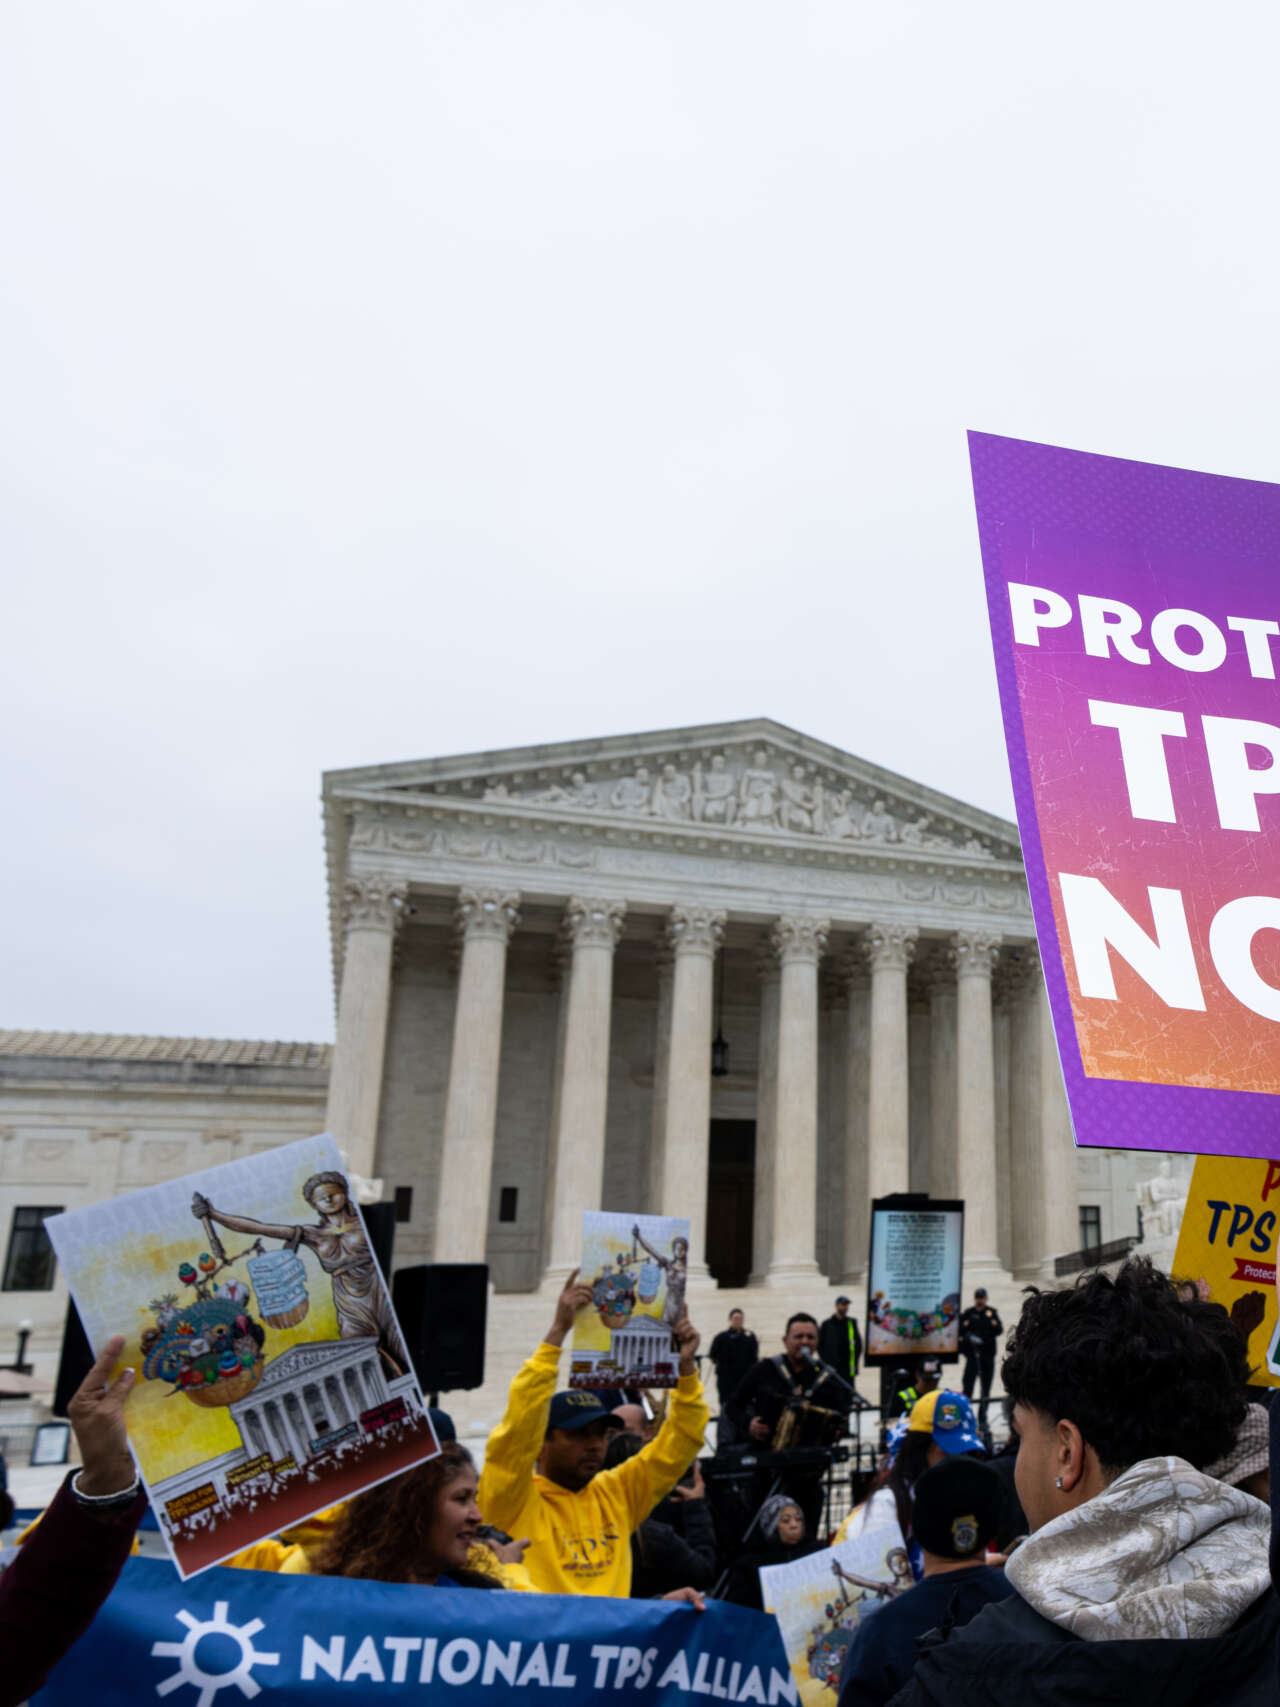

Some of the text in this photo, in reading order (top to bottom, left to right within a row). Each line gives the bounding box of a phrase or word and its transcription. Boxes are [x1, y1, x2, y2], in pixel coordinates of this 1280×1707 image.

[1207, 1200, 1277, 1253] TPS
[300, 1635, 576, 1687] NATIONAL
[591, 1644, 657, 1690] TPS
